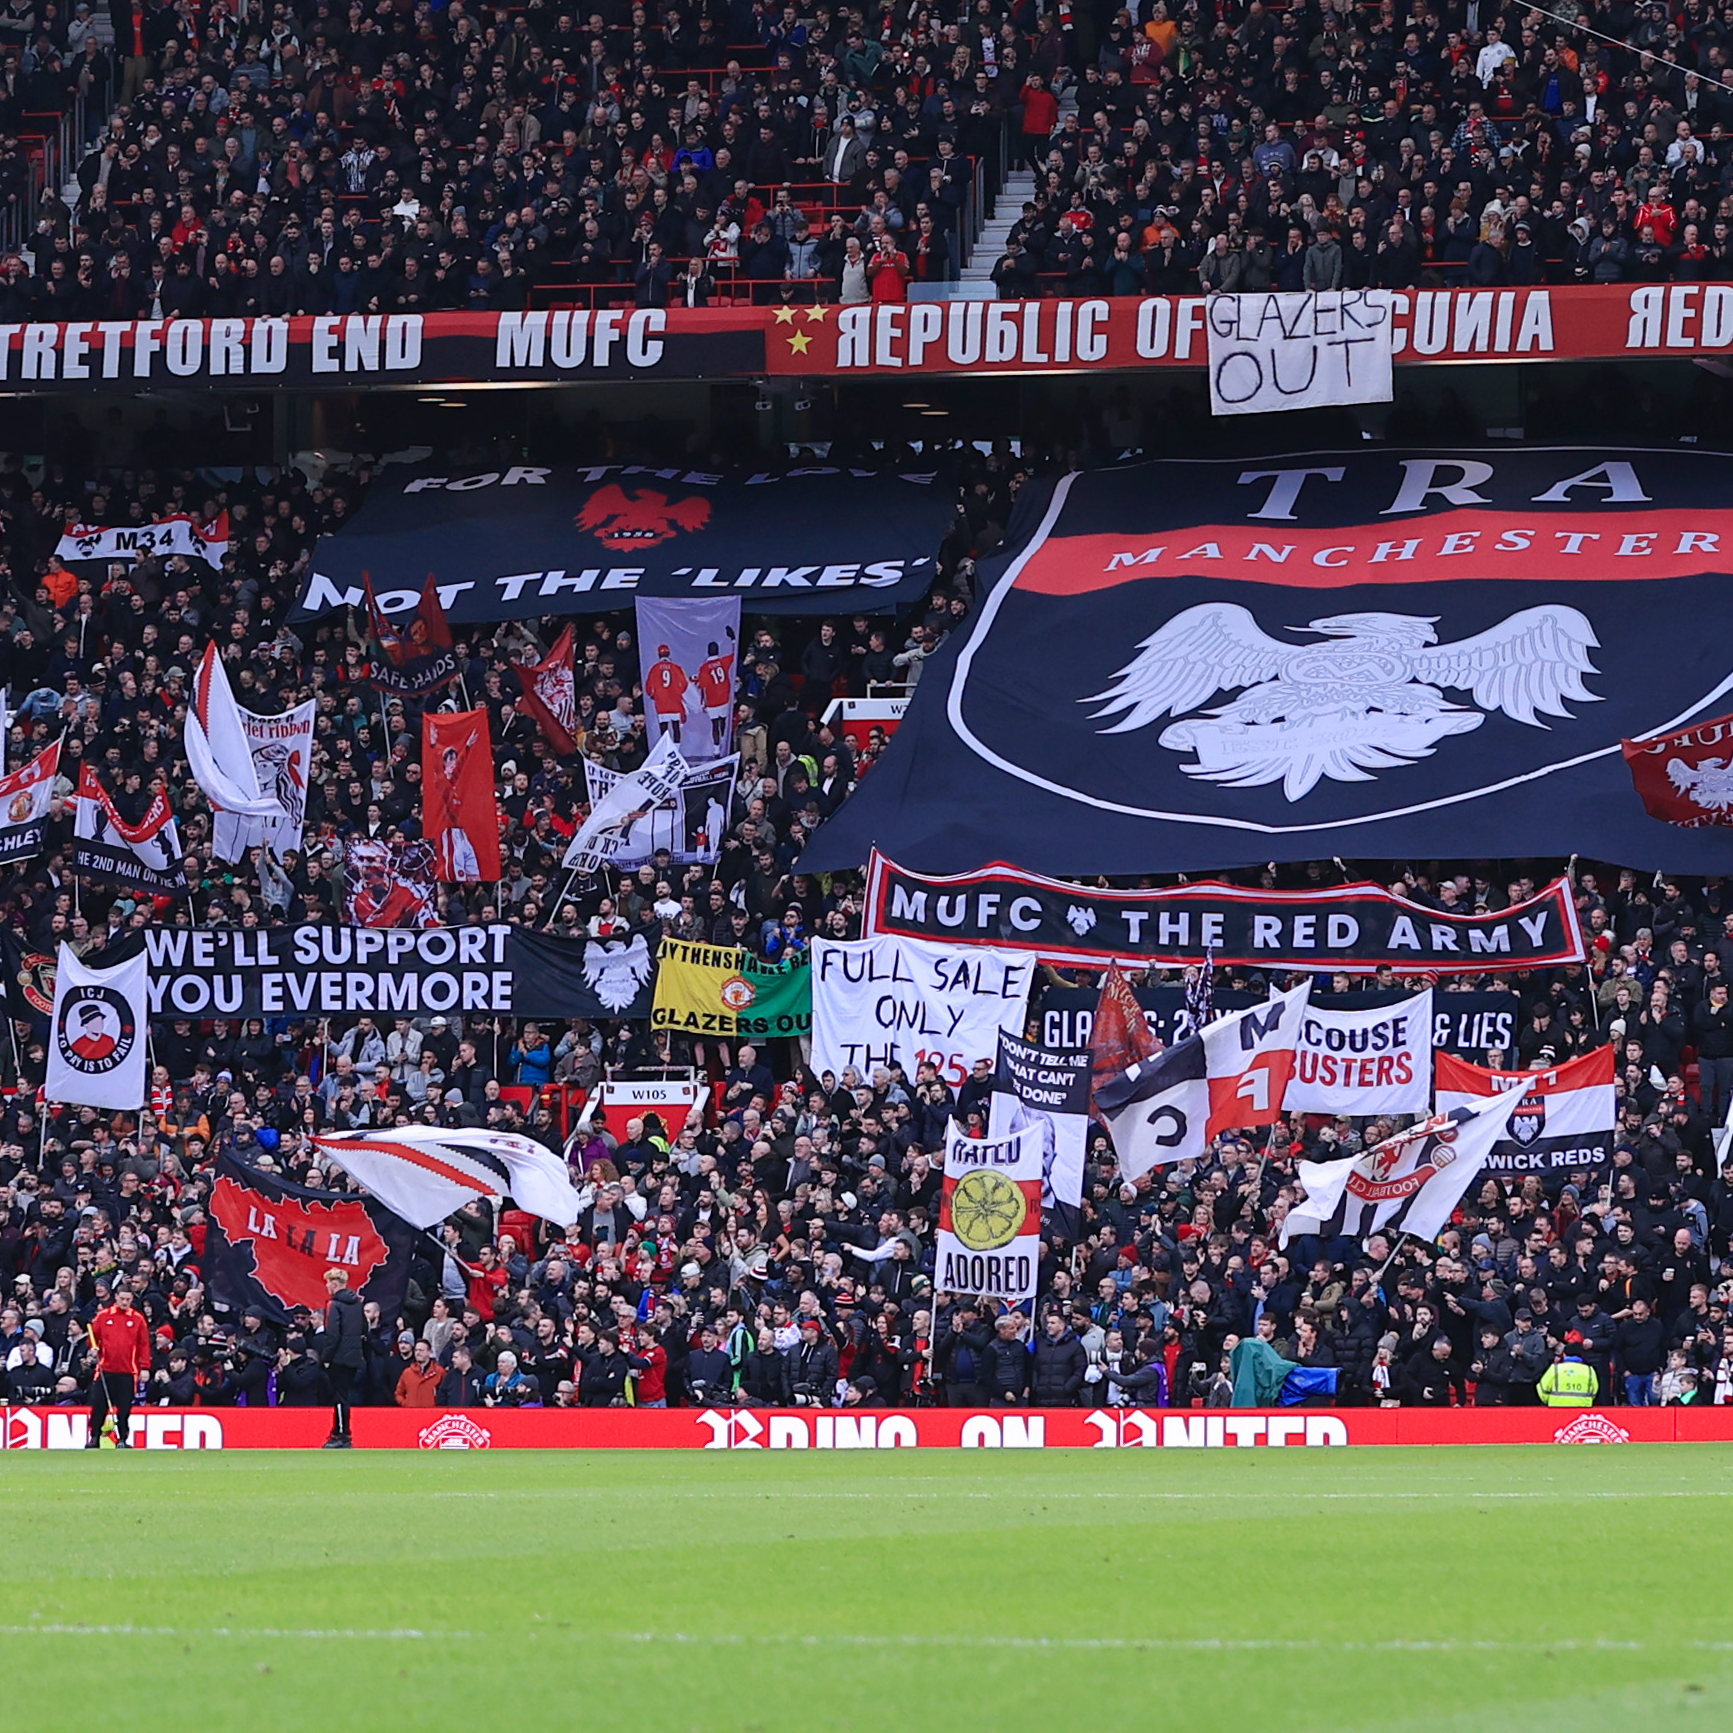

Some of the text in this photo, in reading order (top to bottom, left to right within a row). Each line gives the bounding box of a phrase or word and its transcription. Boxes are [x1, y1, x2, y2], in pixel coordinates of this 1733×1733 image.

[1136, 295, 1205, 360] OF
[1209, 290, 1387, 341] GLAZERS
[311, 313, 423, 373] END
[495, 308, 666, 367] MUFC
[1216, 337, 1376, 403] OUT
[404, 466, 552, 494] FOR
[1236, 459, 1655, 519] TRA
[1103, 528, 1721, 572] MANCHESTER
[303, 573, 474, 618] NOT
[494, 566, 646, 601] THE
[370, 661, 409, 689] SAFE
[662, 670, 671, 687] 9
[710, 667, 725, 685] 19
[891, 884, 1551, 954] MUFC THE RED ARMY
[144, 924, 512, 968] WE'LL SUPPORT
[80, 988, 105, 999] ICJ
[146, 970, 512, 1013] YOU EVERMORE
[820, 948, 914, 983] FULL
[929, 957, 1026, 999] SALE
[652, 1007, 768, 1034] GLAZERS
[875, 994, 965, 1038] ONLY
[1433, 1012, 1513, 1050] & LIES
[64, 1051, 82, 1068] PAY
[84, 1061, 95, 1072] IS
[97, 1061, 113, 1071] TO
[112, 1037, 132, 1062] FAIL
[1040, 1052, 1068, 1067] TELL
[1069, 1054, 1089, 1067] ME
[632, 1089, 667, 1100] W105
[1550, 1146, 1605, 1167] REDS
[247, 1204, 278, 1240] LA
[325, 1233, 361, 1266] LA
[944, 1251, 1031, 1294] ADORED
